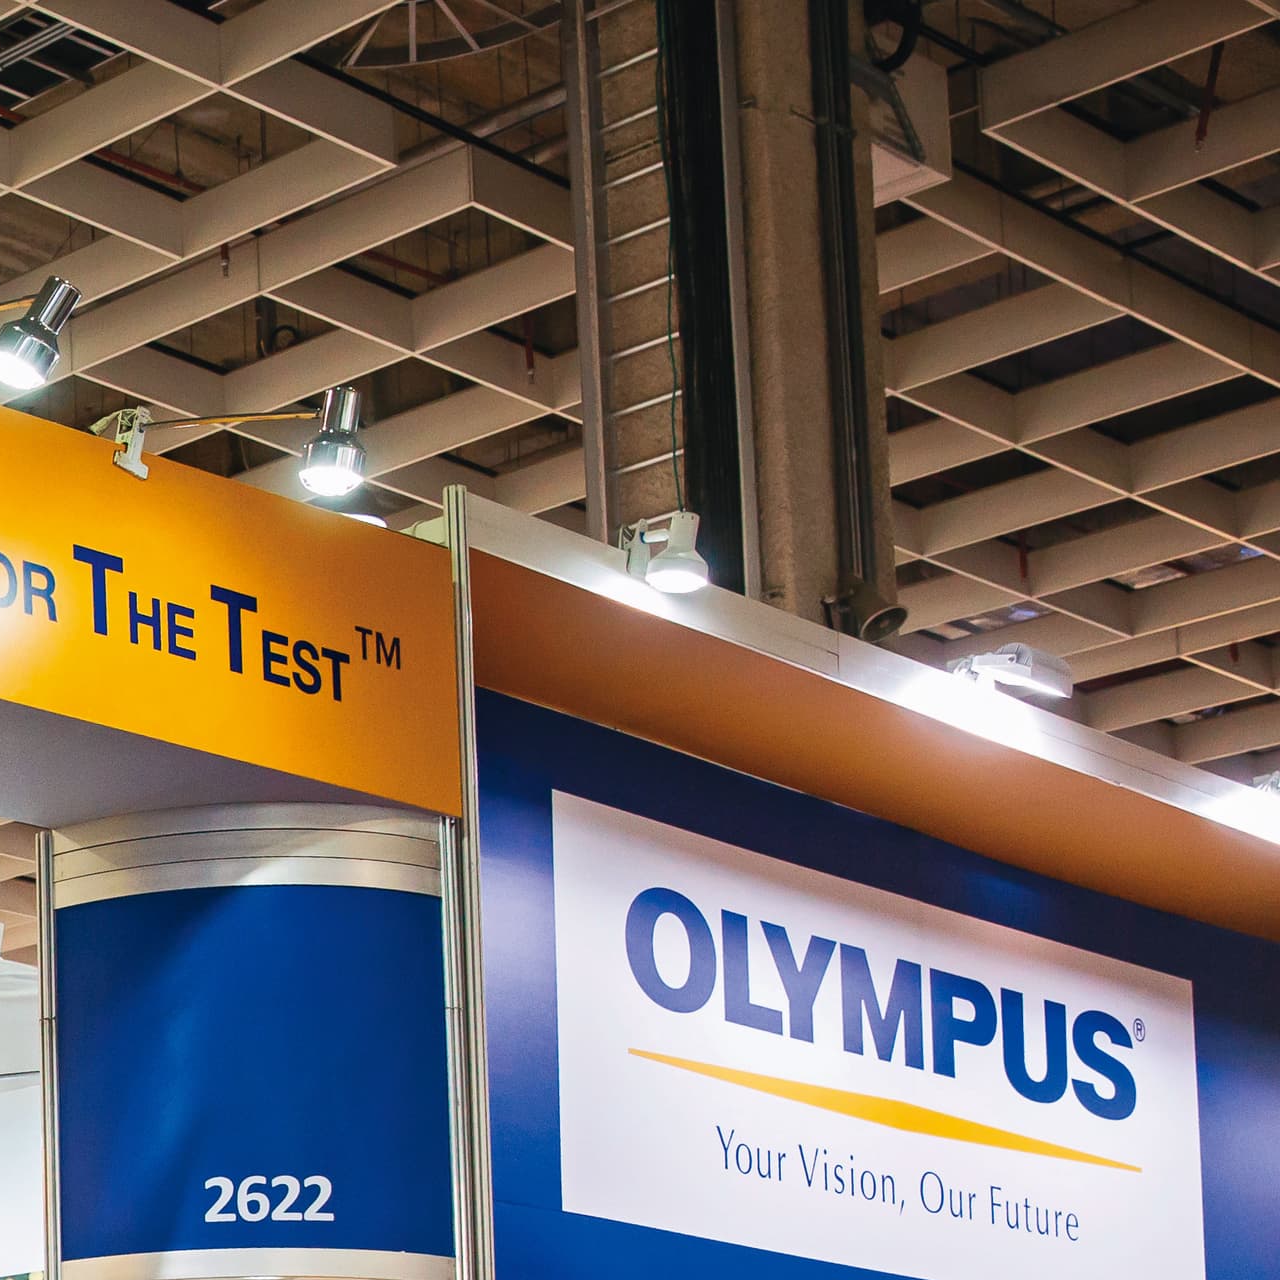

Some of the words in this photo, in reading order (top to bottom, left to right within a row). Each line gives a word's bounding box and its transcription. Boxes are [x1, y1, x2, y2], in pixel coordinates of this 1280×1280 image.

[72, 544, 197, 661] THE
[204, 1175, 335, 1223] 2622
[715, 1124, 786, 1183] Your
[798, 1144, 906, 1216] Vision,
[919, 1170, 976, 1222] Our
[989, 1184, 1080, 1243] Future
